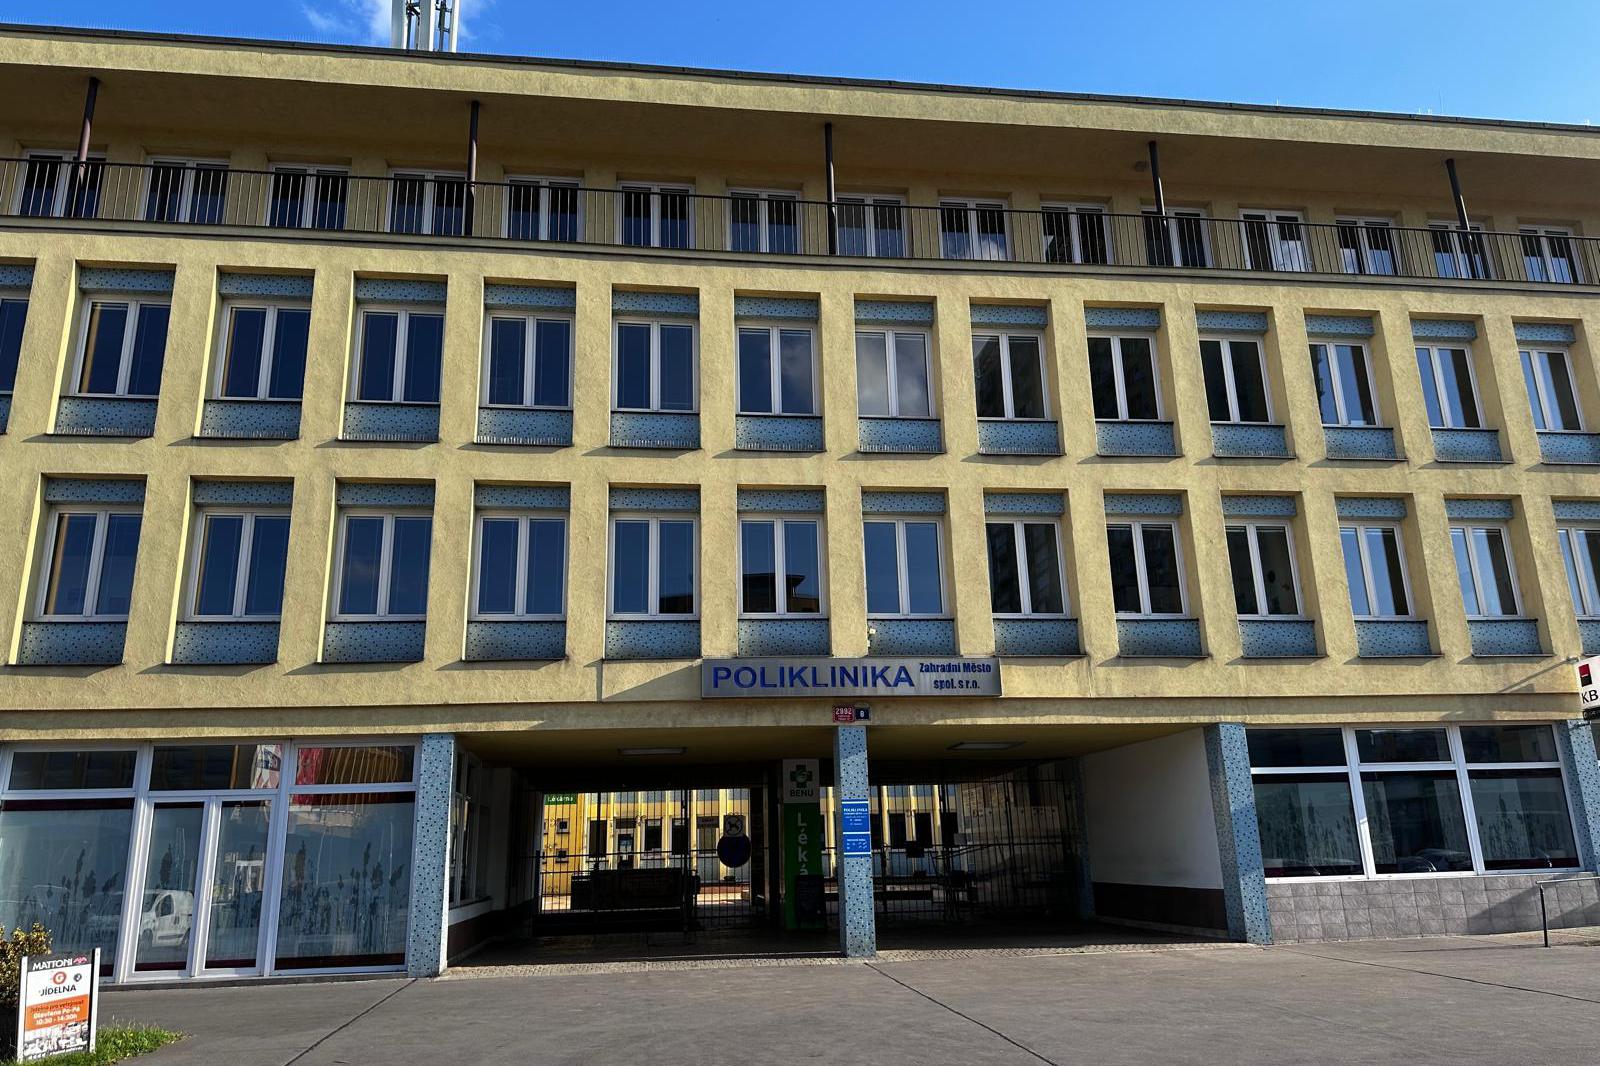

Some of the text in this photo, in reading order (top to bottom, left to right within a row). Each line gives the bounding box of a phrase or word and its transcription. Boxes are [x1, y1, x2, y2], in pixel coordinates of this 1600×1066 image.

[919, 661, 992, 674] Zahradní Město
[712, 665, 915, 689] POLIKLINIKA
[933, 678, 981, 690] spol. s r.o.
[1581, 689, 1599, 704] KB
[790, 789, 814, 797] BENU
[32, 958, 73, 971] MATTONI
[40, 984, 77, 997] JÍDELNA
